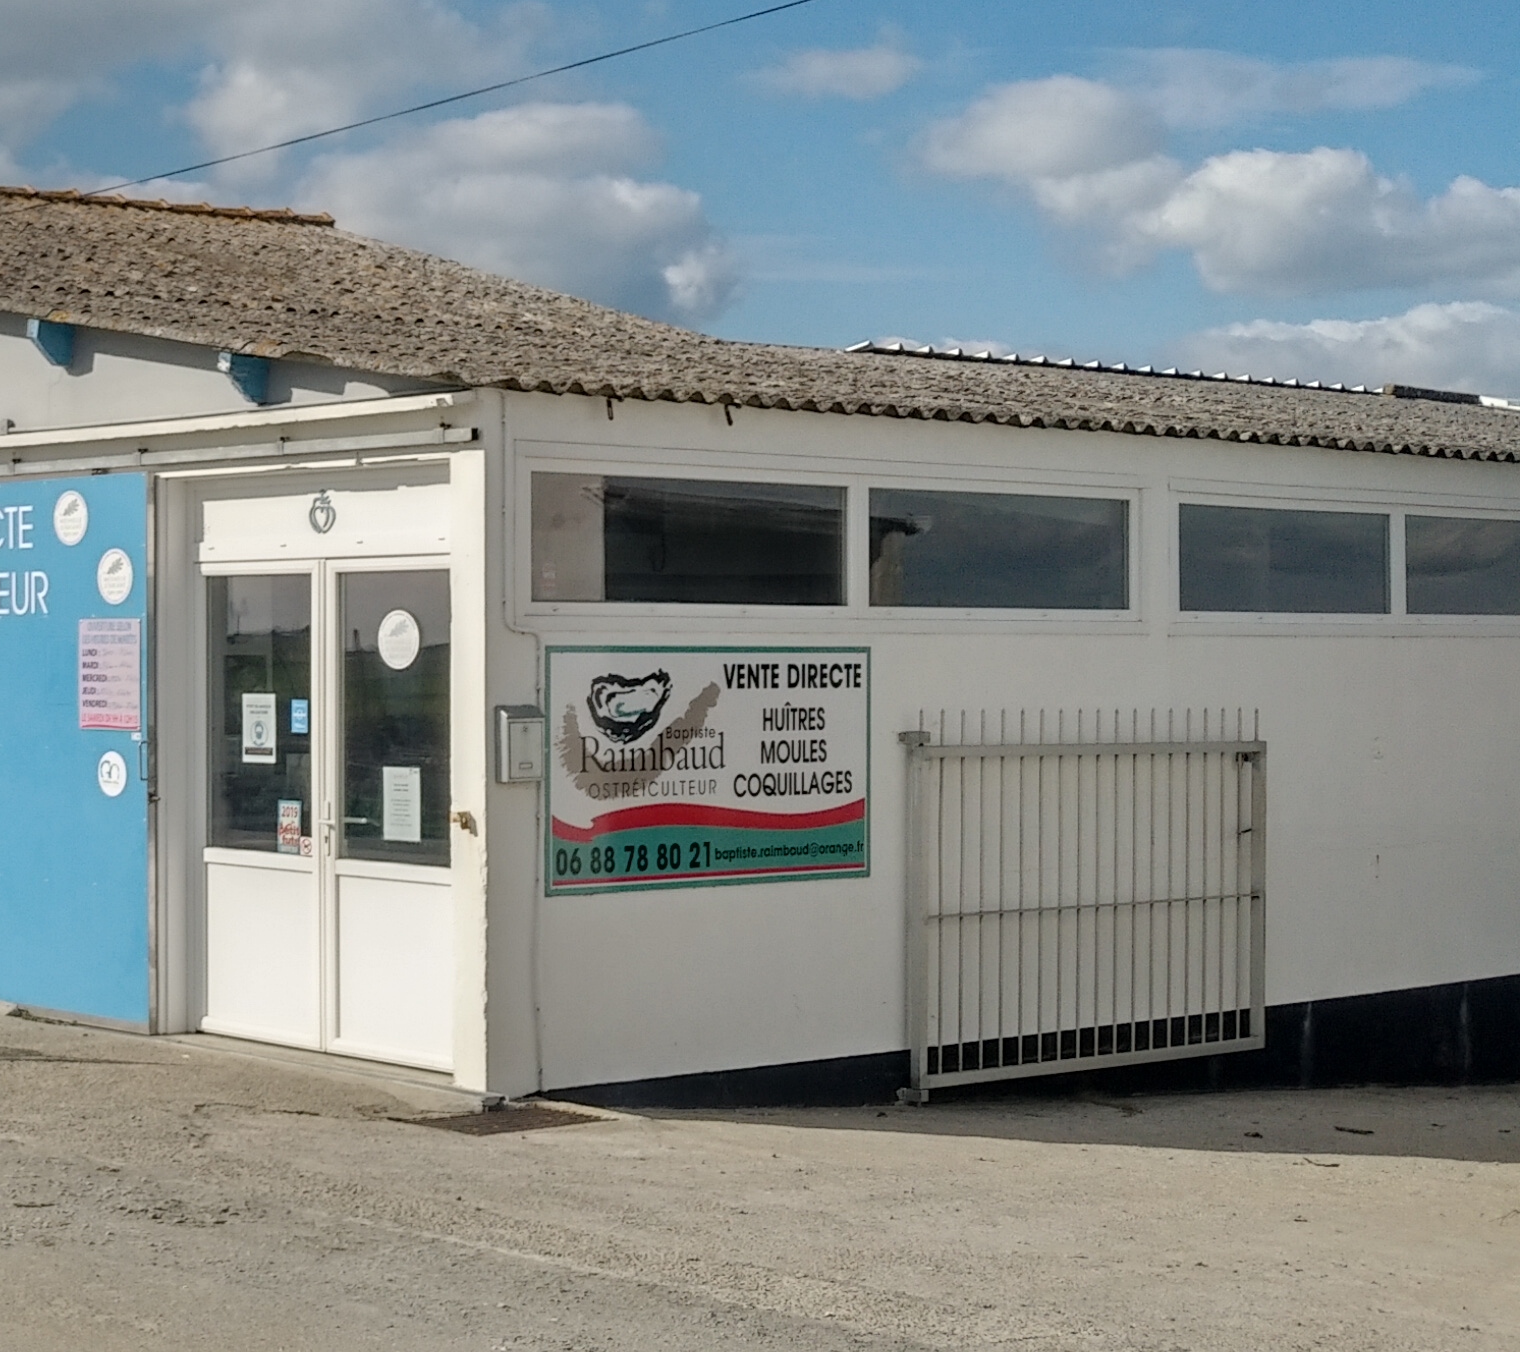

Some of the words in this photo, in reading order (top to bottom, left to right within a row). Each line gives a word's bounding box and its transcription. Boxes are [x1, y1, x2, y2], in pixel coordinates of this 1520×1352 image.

[723, 663, 780, 689] VENTE
[787, 663, 862, 689] DIRECTE
[762, 701, 826, 732] HUÎTRES
[665, 726, 716, 741] Baptiste
[579, 732, 726, 774] Raimbaud
[760, 739, 828, 764] MOULES
[733, 771, 853, 798] COQUILLAGES
[281, 805, 298, 818] 2019
[555, 847, 582, 876] 06
[590, 846, 616, 874] 88
[624, 844, 648, 873] 78
[656, 842, 681, 870] 80
[689, 841, 711, 868] 21
[714, 841, 864, 861] baptiste.raimbaud@orange.fr
